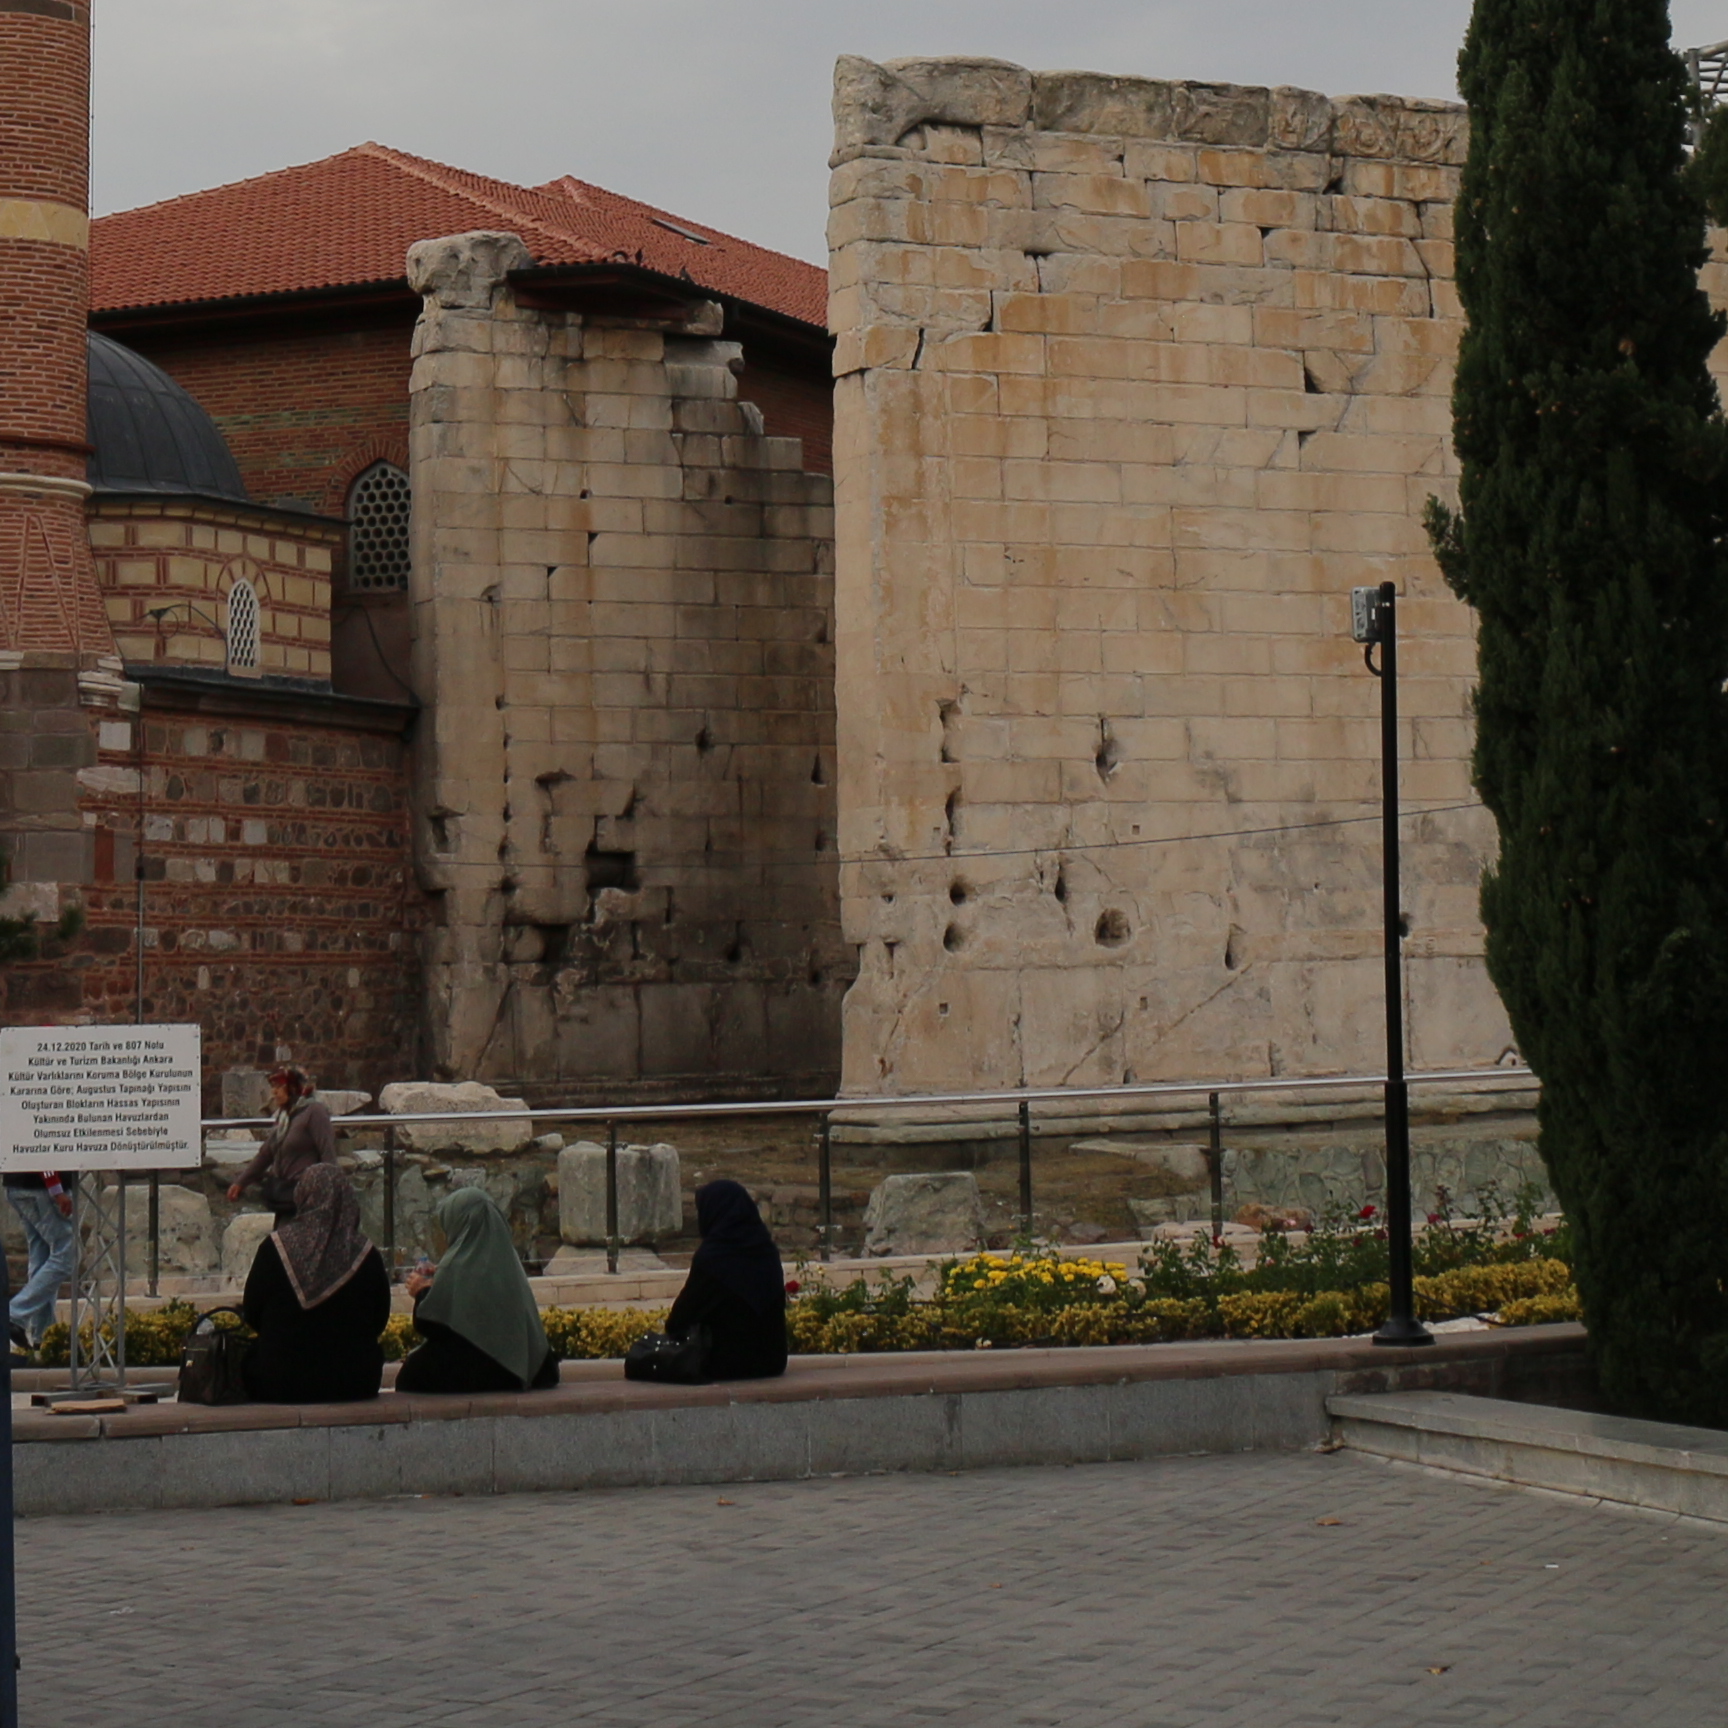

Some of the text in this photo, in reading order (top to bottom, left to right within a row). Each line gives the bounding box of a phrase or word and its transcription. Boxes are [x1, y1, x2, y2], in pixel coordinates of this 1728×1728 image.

[37, 1040, 164, 1052] 24.12.2020 Tarih ve 807 Nolu
[28, 1057, 54, 1066] Kültür
[57, 1058, 67, 1066] ve
[100, 1055, 141, 1065] Bakanlığı
[143, 1055, 174, 1064] Ankara
[8, 1068, 193, 1081] Kültür Varlıklarını Koruma Bölge Kurulunun
[10, 1087, 47, 1096] Kararına
[76, 1084, 116, 1095] Augustus
[119, 1083, 155, 1094] Tapınağı
[157, 1083, 191, 1094] Yapısını
[21, 1097, 180, 1112] Oluşturan Blokların Hassas Yapısının
[33, 1113, 169, 1124] Yakınında Bulunan Havuzlardan
[33, 1126, 168, 1138] Olumsuz Etkilenmesi Sebebiyle
[12, 1141, 190, 1154] Havuzlar Kuru Havuza Dönüştürülmüştür.
